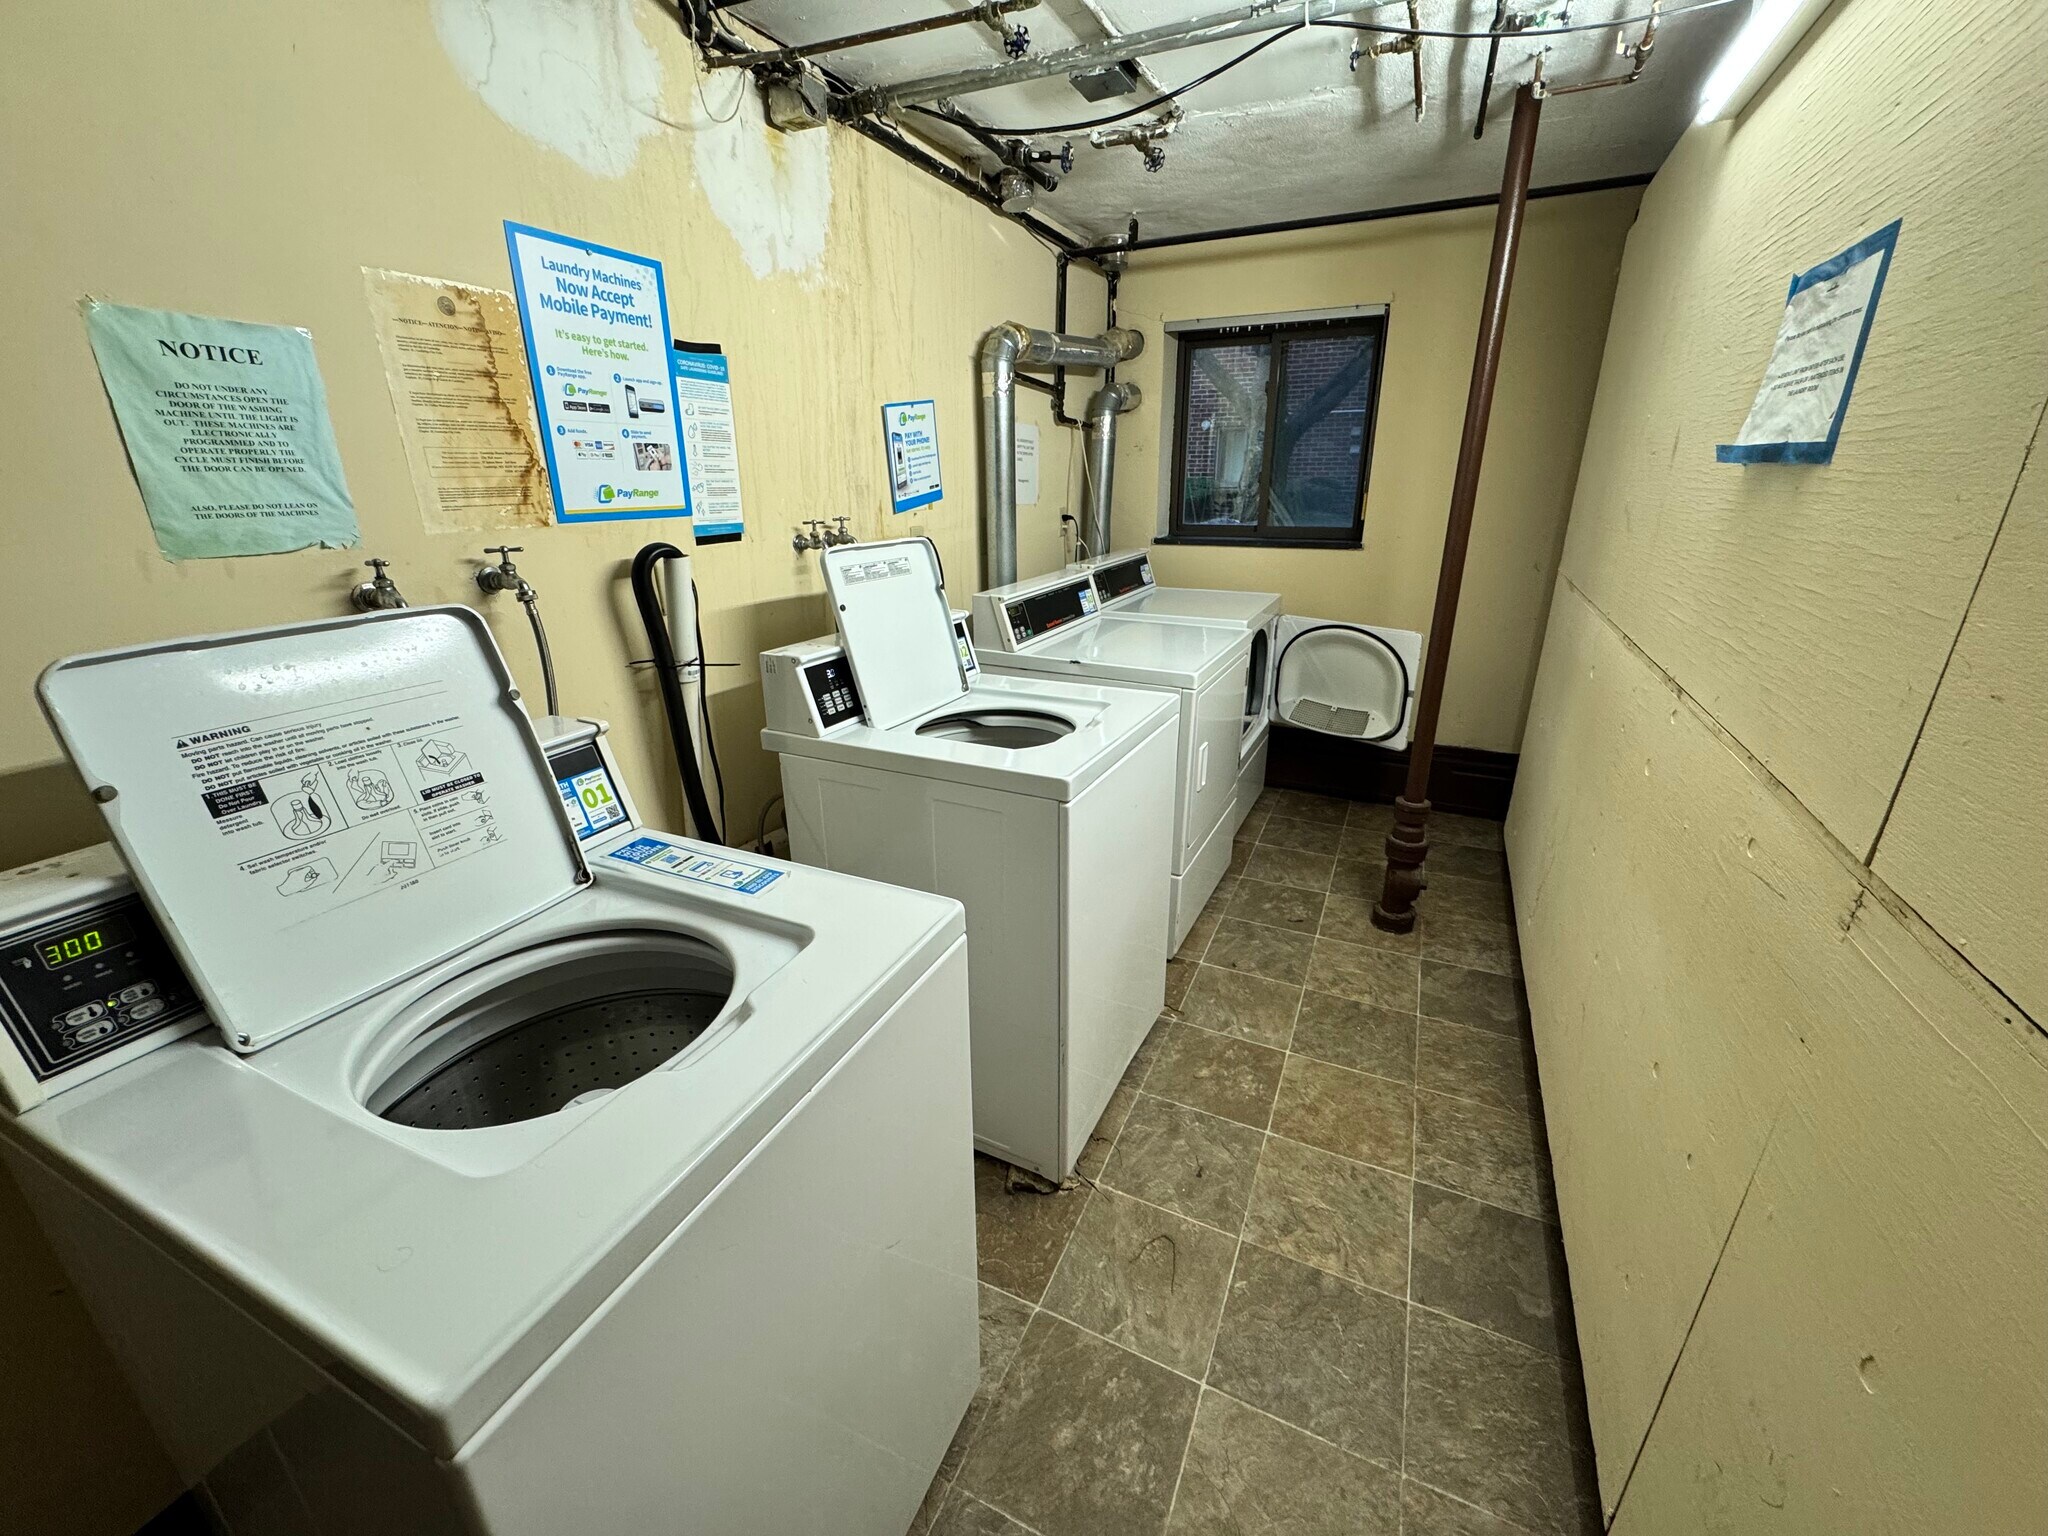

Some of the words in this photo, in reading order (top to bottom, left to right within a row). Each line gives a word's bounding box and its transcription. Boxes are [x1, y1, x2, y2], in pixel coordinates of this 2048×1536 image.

[541, 256, 590, 281] Laundry
[592, 269, 641, 291] Machines
[556, 277, 588, 297] Now
[592, 285, 635, 309] Accept
[540, 294, 588, 316] Mobile
[591, 304, 652, 328] Payment!
[572, 332, 590, 345] easy
[593, 336, 602, 344] to
[604, 338, 616, 348] get
[618, 339, 648, 352] started.
[156, 339, 263, 365] NOTICE
[582, 346, 608, 358] Here's
[610, 350, 629, 361] how.
[175, 382, 189, 390] DO
[192, 383, 212, 391] NOT
[215, 385, 247, 394] UNDER
[250, 387, 268, 395] ANY
[578, 387, 607, 397] PayRange
[155, 390, 241, 402] CIRCUMSTANCES
[244, 395, 268, 404] OPEN
[270, 397, 289, 405] THE
[169, 401, 200, 409] DOOR
[219, 403, 236, 411] THE
[239, 405, 282, 413] WASHING
[155, 409, 205, 419] MACHINE
[208, 412, 237, 420] UNTIL
[239, 413, 258, 421] THE
[260, 414, 287, 422] LIGHT
[163, 419, 189, 427] OUT.
[193, 421, 226, 429] THESE
[228, 422, 276, 431] MACHINES
[191, 430, 277, 439] ELECTRONICALLY
[183, 438, 255, 447] PROGRAMMED
[617, 488, 659, 499] PayRange
[180, 749, 207, 758] Moving
[208, 745, 225, 754] parts
[283, 727, 305, 735] serious
[306, 723, 322, 731] injury
[189, 725, 251, 745] WARNING
[204, 753, 221, 761] NOT
[222, 749, 239, 757] reach
[264, 738, 284, 747] washer
[306, 727, 326, 737] moving
[208, 760, 223, 768] NOT
[234, 752, 258, 761] children
[305, 736, 325, 744] washer.
[206, 766, 231, 775] hazard.
[241, 758, 263, 767] reduce
[454, 776, 473, 784] CLOSED
[212, 790, 228, 798] THIS
[229, 785, 247, 793] MUST
[431, 787, 454, 797] OPERATE
[455, 781, 475, 789] WASHER
[582, 783, 613, 809] 01
[215, 795, 235, 803] DONE
[216, 815, 243, 824] Measure
[219, 819, 249, 830] detergent
[249, 866, 267, 875] fabric
[268, 859, 290, 869] selector
[291, 850, 317, 861] switches.
[45, 931, 103, 965] 300
